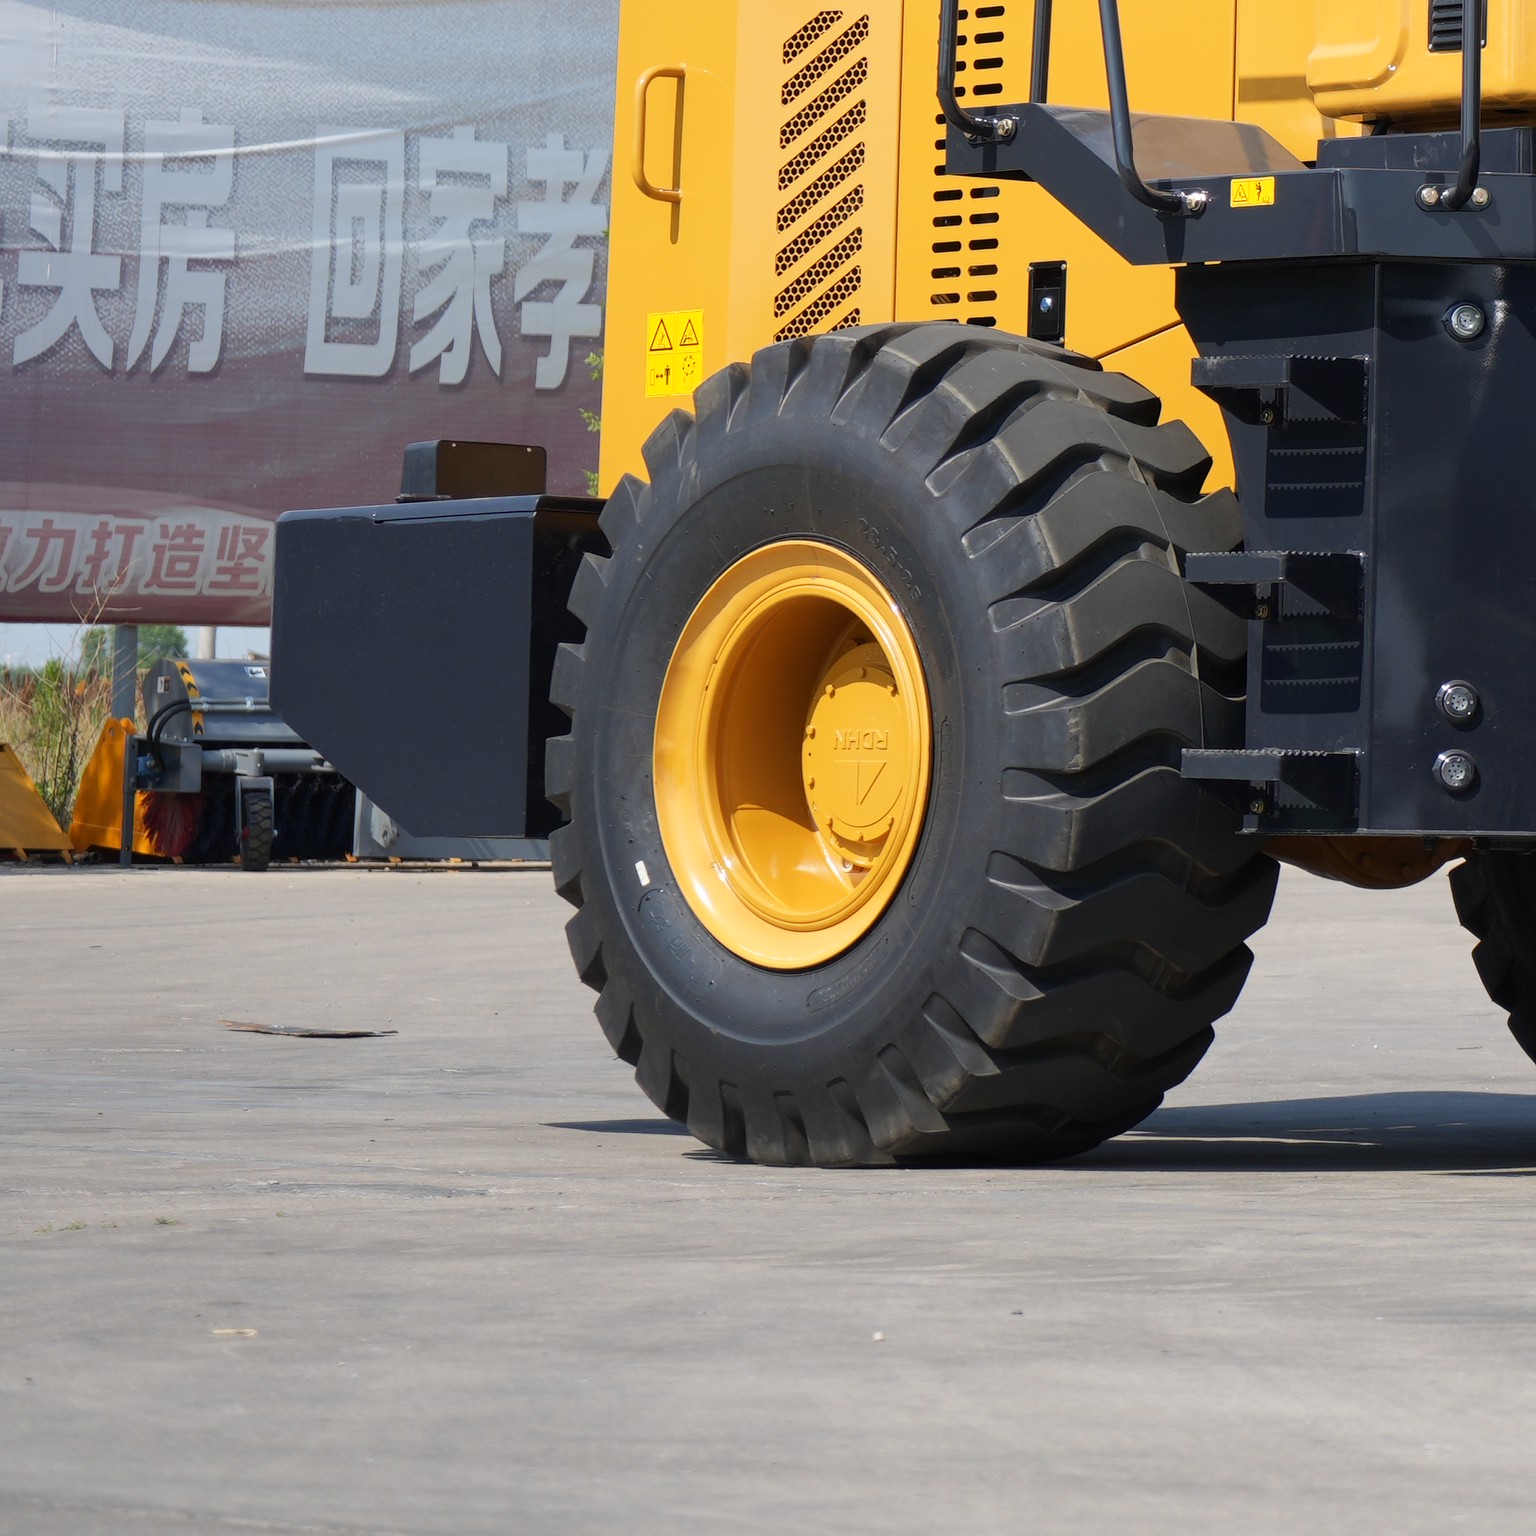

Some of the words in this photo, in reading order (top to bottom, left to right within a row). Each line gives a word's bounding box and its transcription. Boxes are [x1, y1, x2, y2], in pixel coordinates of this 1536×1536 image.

[0, 107, 235, 375] 买房
[303, 125, 612, 390] 回家孝
[0, 519, 269, 589] 力打造坚
[832, 728, 889, 751] RDHN
